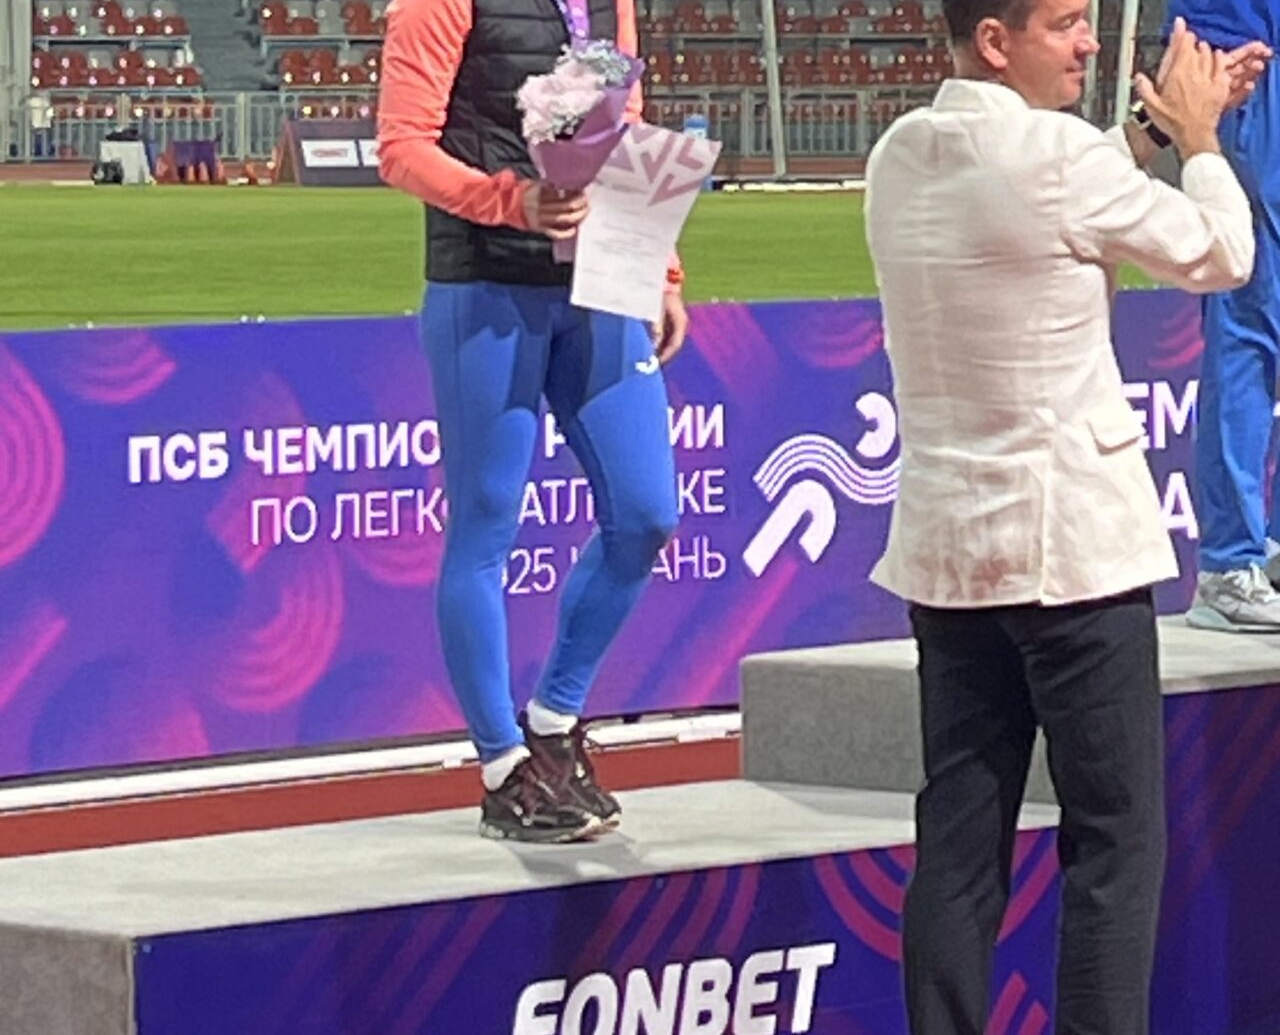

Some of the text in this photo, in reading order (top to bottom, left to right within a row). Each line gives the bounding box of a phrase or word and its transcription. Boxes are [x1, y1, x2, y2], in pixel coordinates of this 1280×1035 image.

[128, 431, 229, 483] ПСБ
[243, 420, 441, 475] ЧЕМПИО
[251, 496, 318, 546] ПО
[331, 487, 448, 540] ЛЕГК
[512, 943, 837, 1035] FONBET
